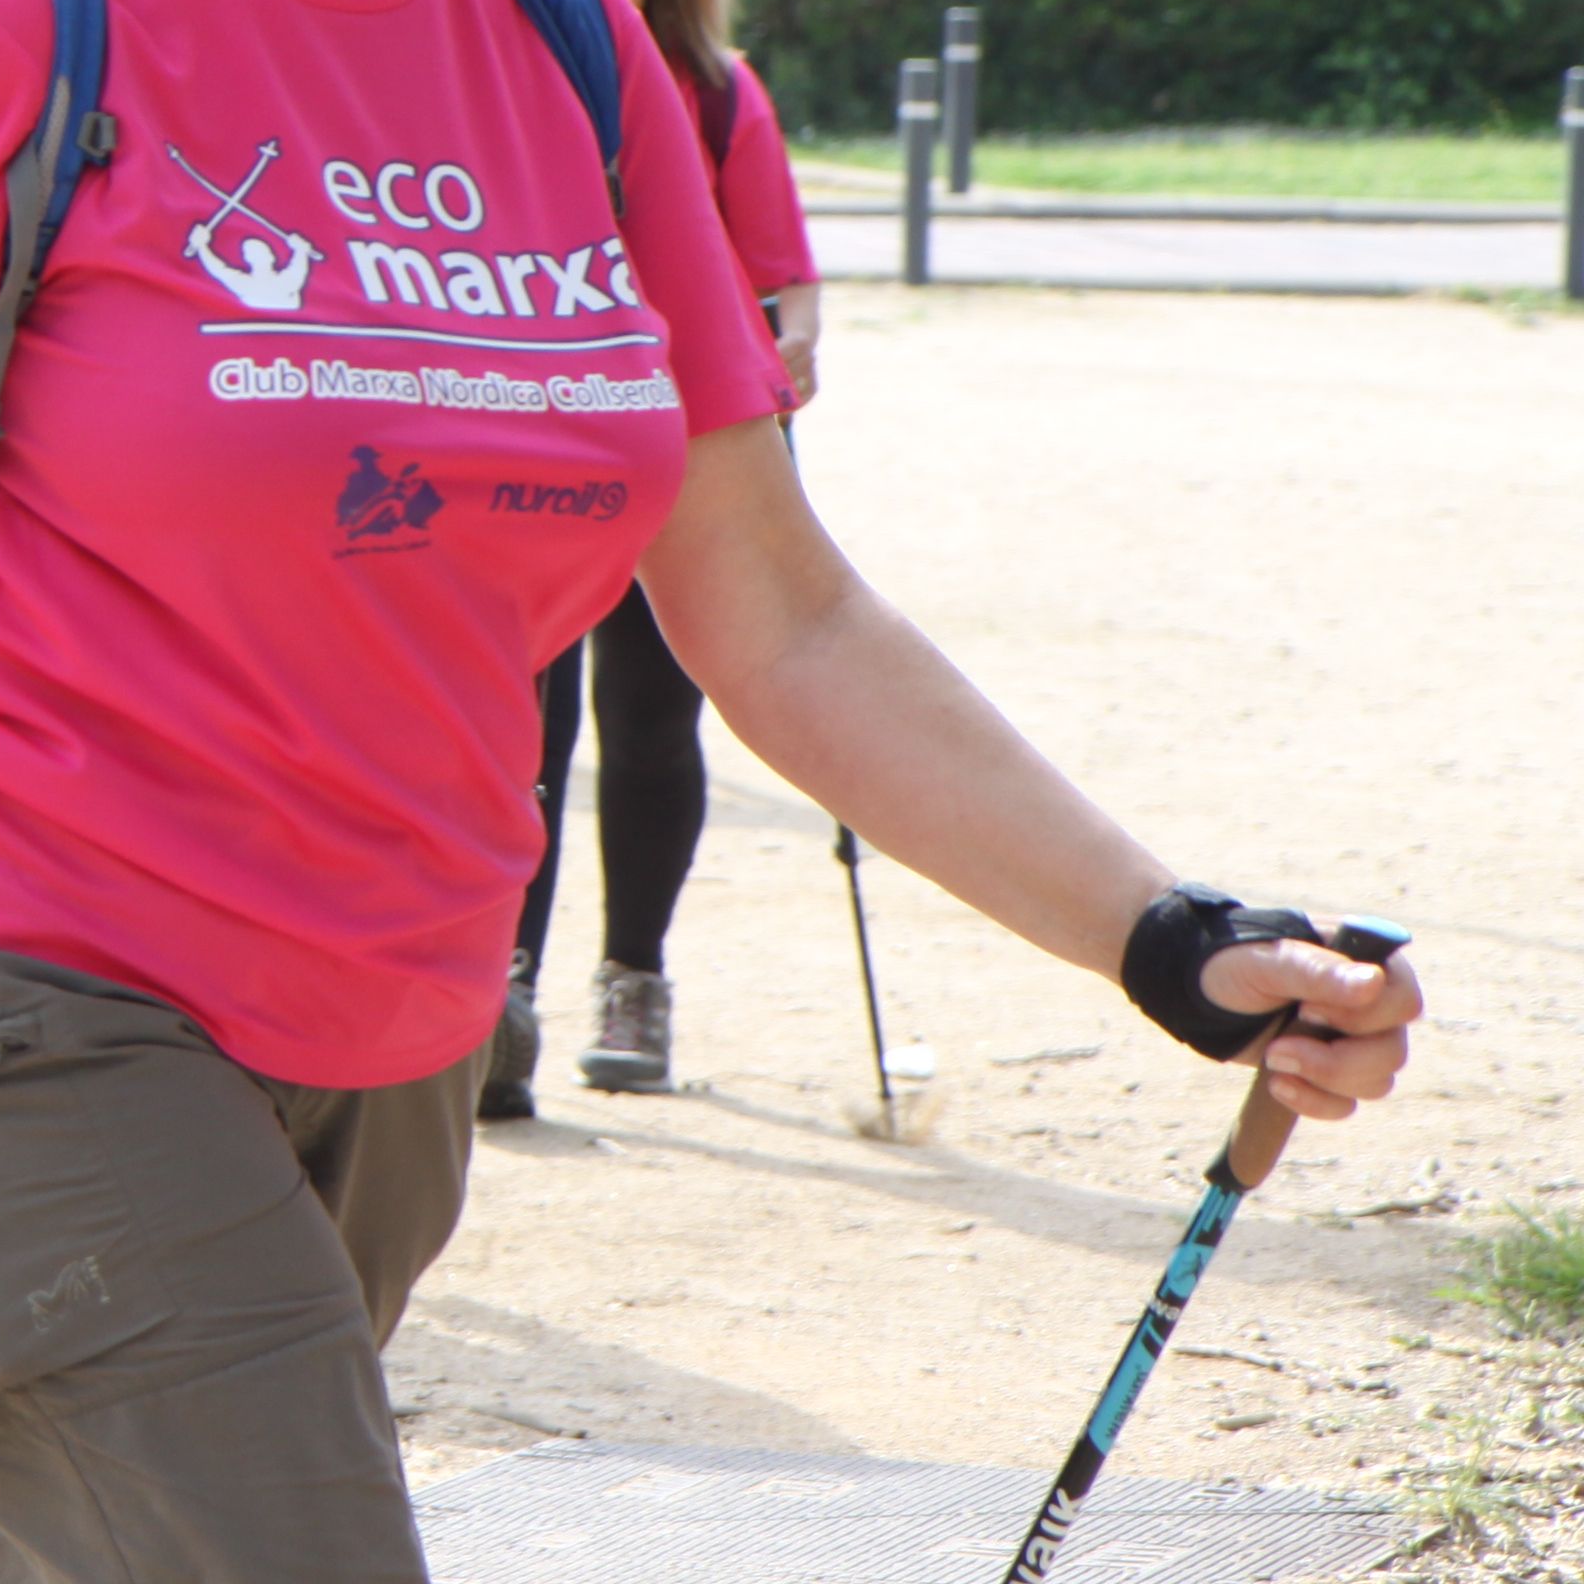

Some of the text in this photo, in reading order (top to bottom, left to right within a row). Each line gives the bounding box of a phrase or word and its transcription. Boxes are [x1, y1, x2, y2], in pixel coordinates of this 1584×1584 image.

[323, 159, 485, 232] eco
[347, 235, 643, 317] marxa
[212, 360, 306, 397] Club
[314, 364, 416, 401] Marxa
[425, 367, 547, 410] Nòrdica
[489, 481, 601, 517] nuroil
